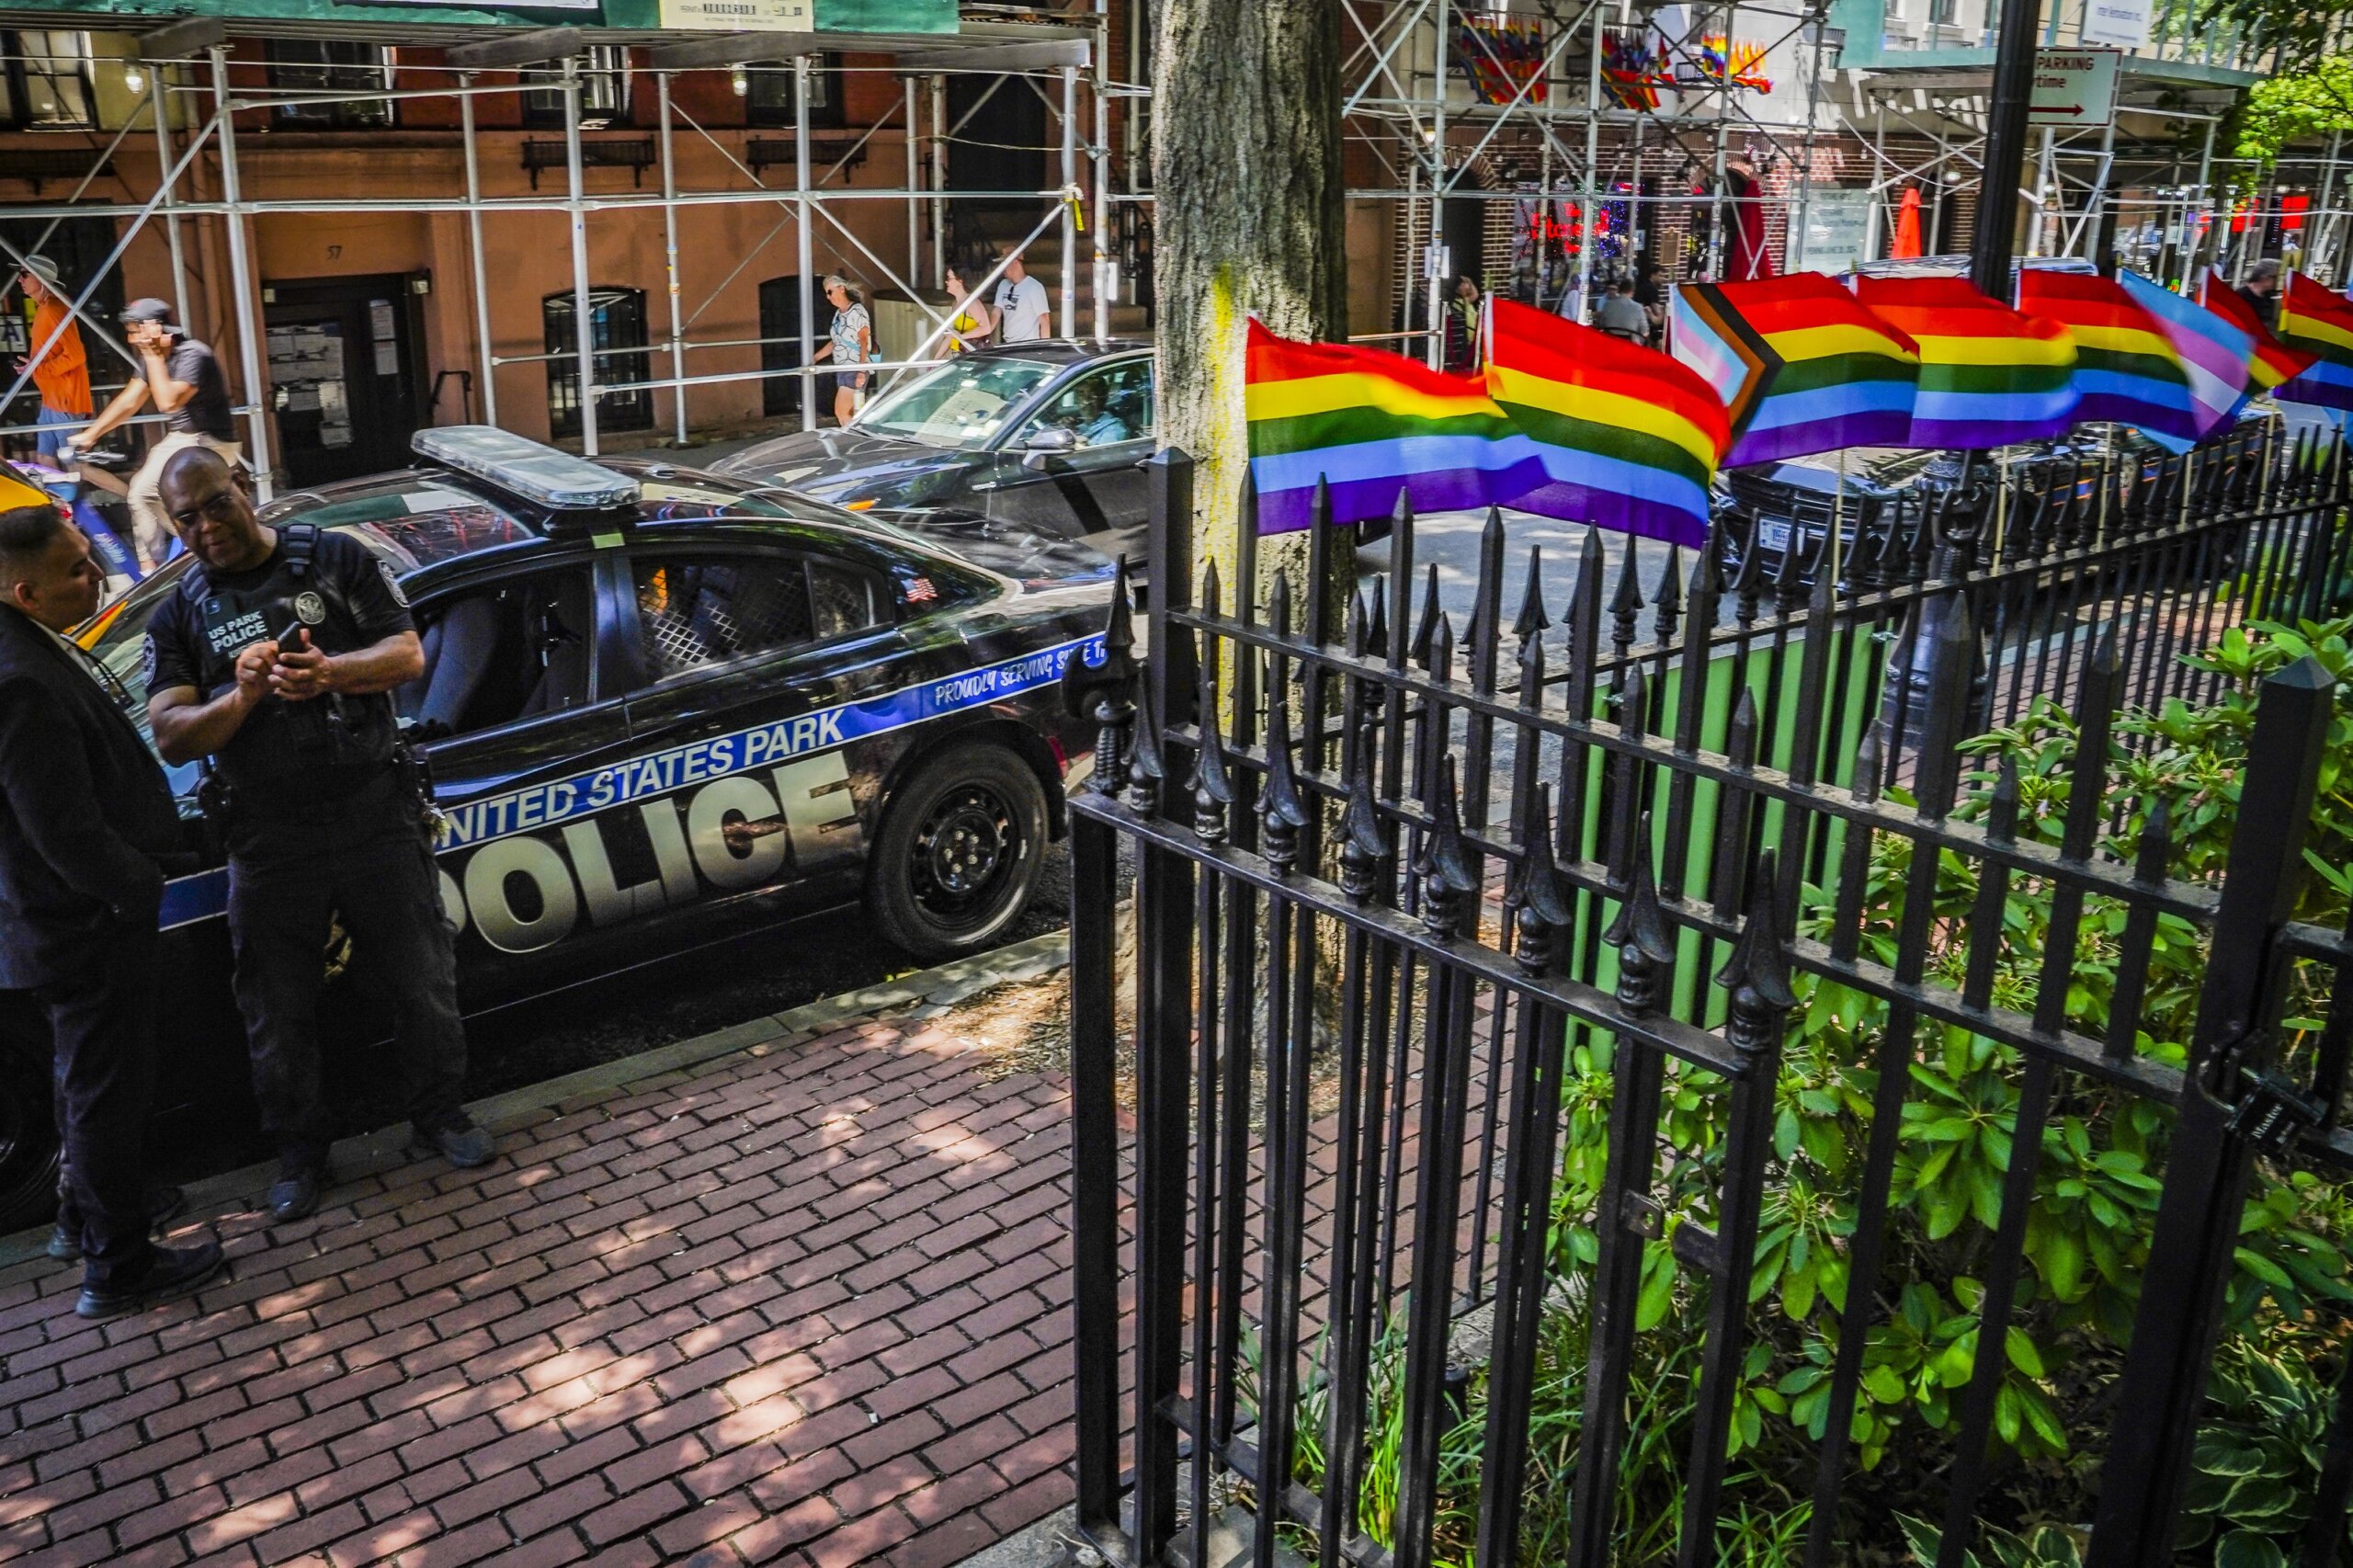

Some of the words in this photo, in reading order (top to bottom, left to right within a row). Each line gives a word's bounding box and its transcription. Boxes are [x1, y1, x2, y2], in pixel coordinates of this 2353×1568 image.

[2036, 56, 2095, 71] PARKING
[2034, 74, 2067, 88] time
[326, 244, 343, 261] 57
[1, 320, 20, 342] A
[208, 625, 226, 640] US
[226, 610, 263, 631] PARK
[211, 620, 267, 653] POLICE
[935, 668, 997, 706] PROUDLY
[1000, 653, 1053, 687] SERVING
[433, 782, 578, 848] NITED
[587, 738, 734, 808] STATES
[744, 708, 846, 767] PARK
[2251, 1103, 2282, 1139] Master
